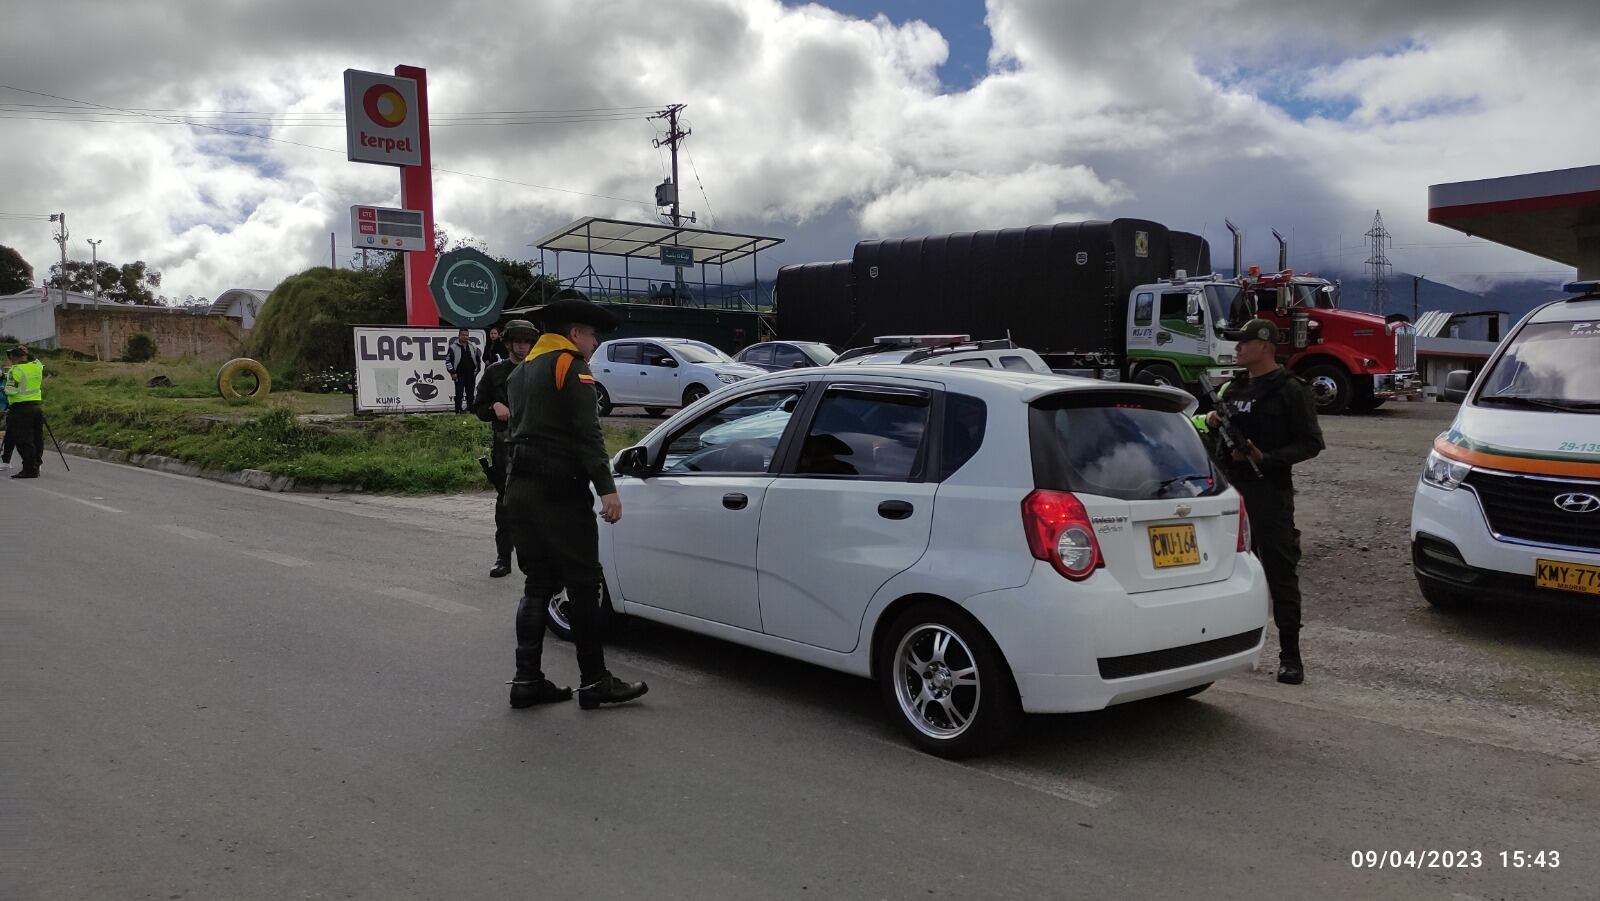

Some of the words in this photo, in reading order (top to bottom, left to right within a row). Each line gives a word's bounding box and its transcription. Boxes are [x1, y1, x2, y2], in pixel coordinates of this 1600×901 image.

[360, 131, 412, 153] terpel
[360, 335, 481, 361] LACTE
[1538, 564, 1600, 588] KMY-77
